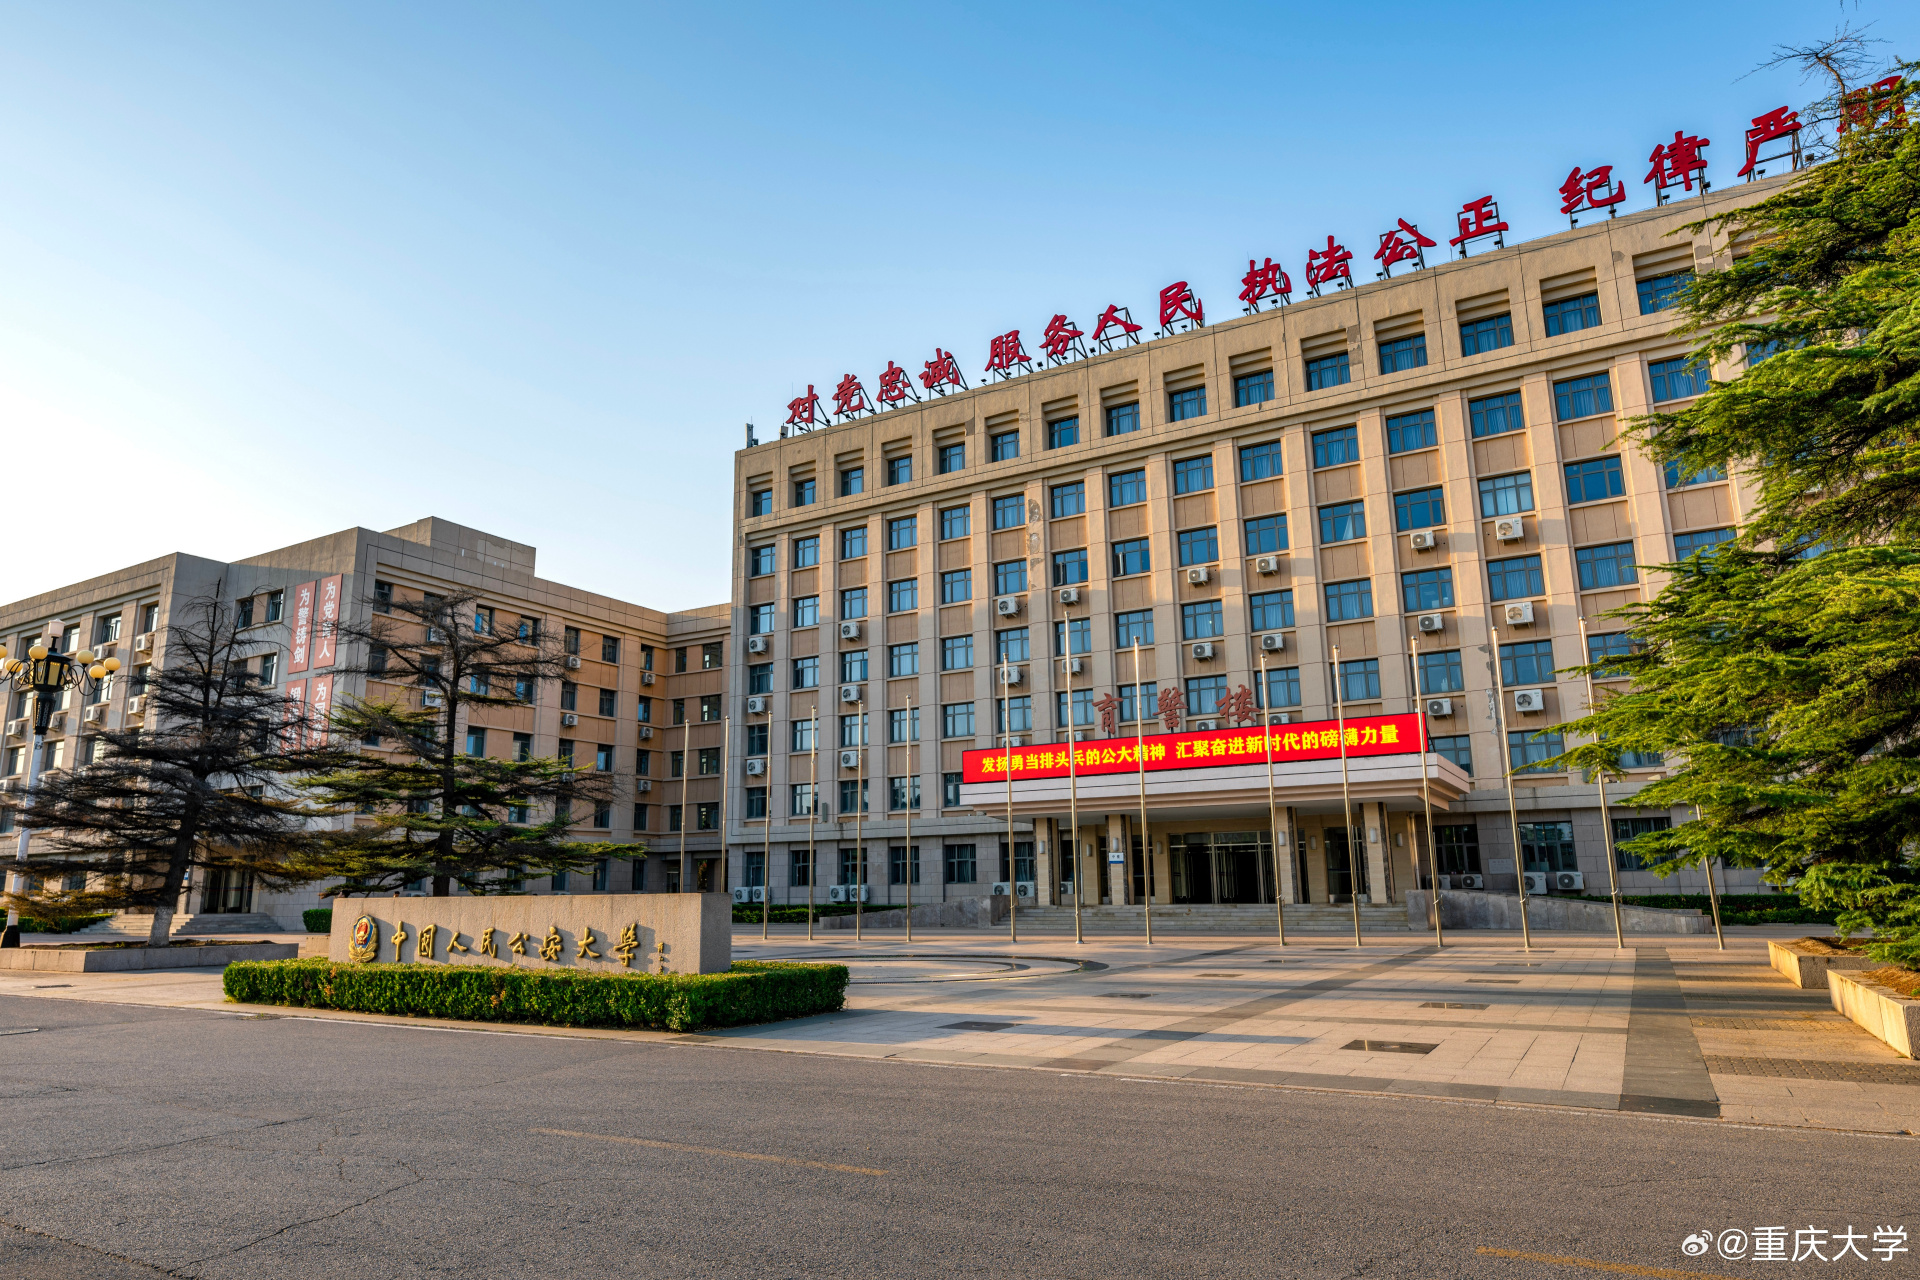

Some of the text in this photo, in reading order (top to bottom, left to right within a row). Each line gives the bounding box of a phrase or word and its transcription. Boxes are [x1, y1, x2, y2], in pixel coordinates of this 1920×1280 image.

[786, 348, 960, 424] 对党忠诚
[984, 280, 1204, 372] 服务人民
[1238, 195, 1509, 306] 执法公正
[293, 588, 310, 663] 为警铸剑
[1091, 683, 1262, 735] 育警楼
[981, 723, 1400, 774] 发扬勇当排头兵的公大精神 汇聚奋进新时代的磅礴力量
